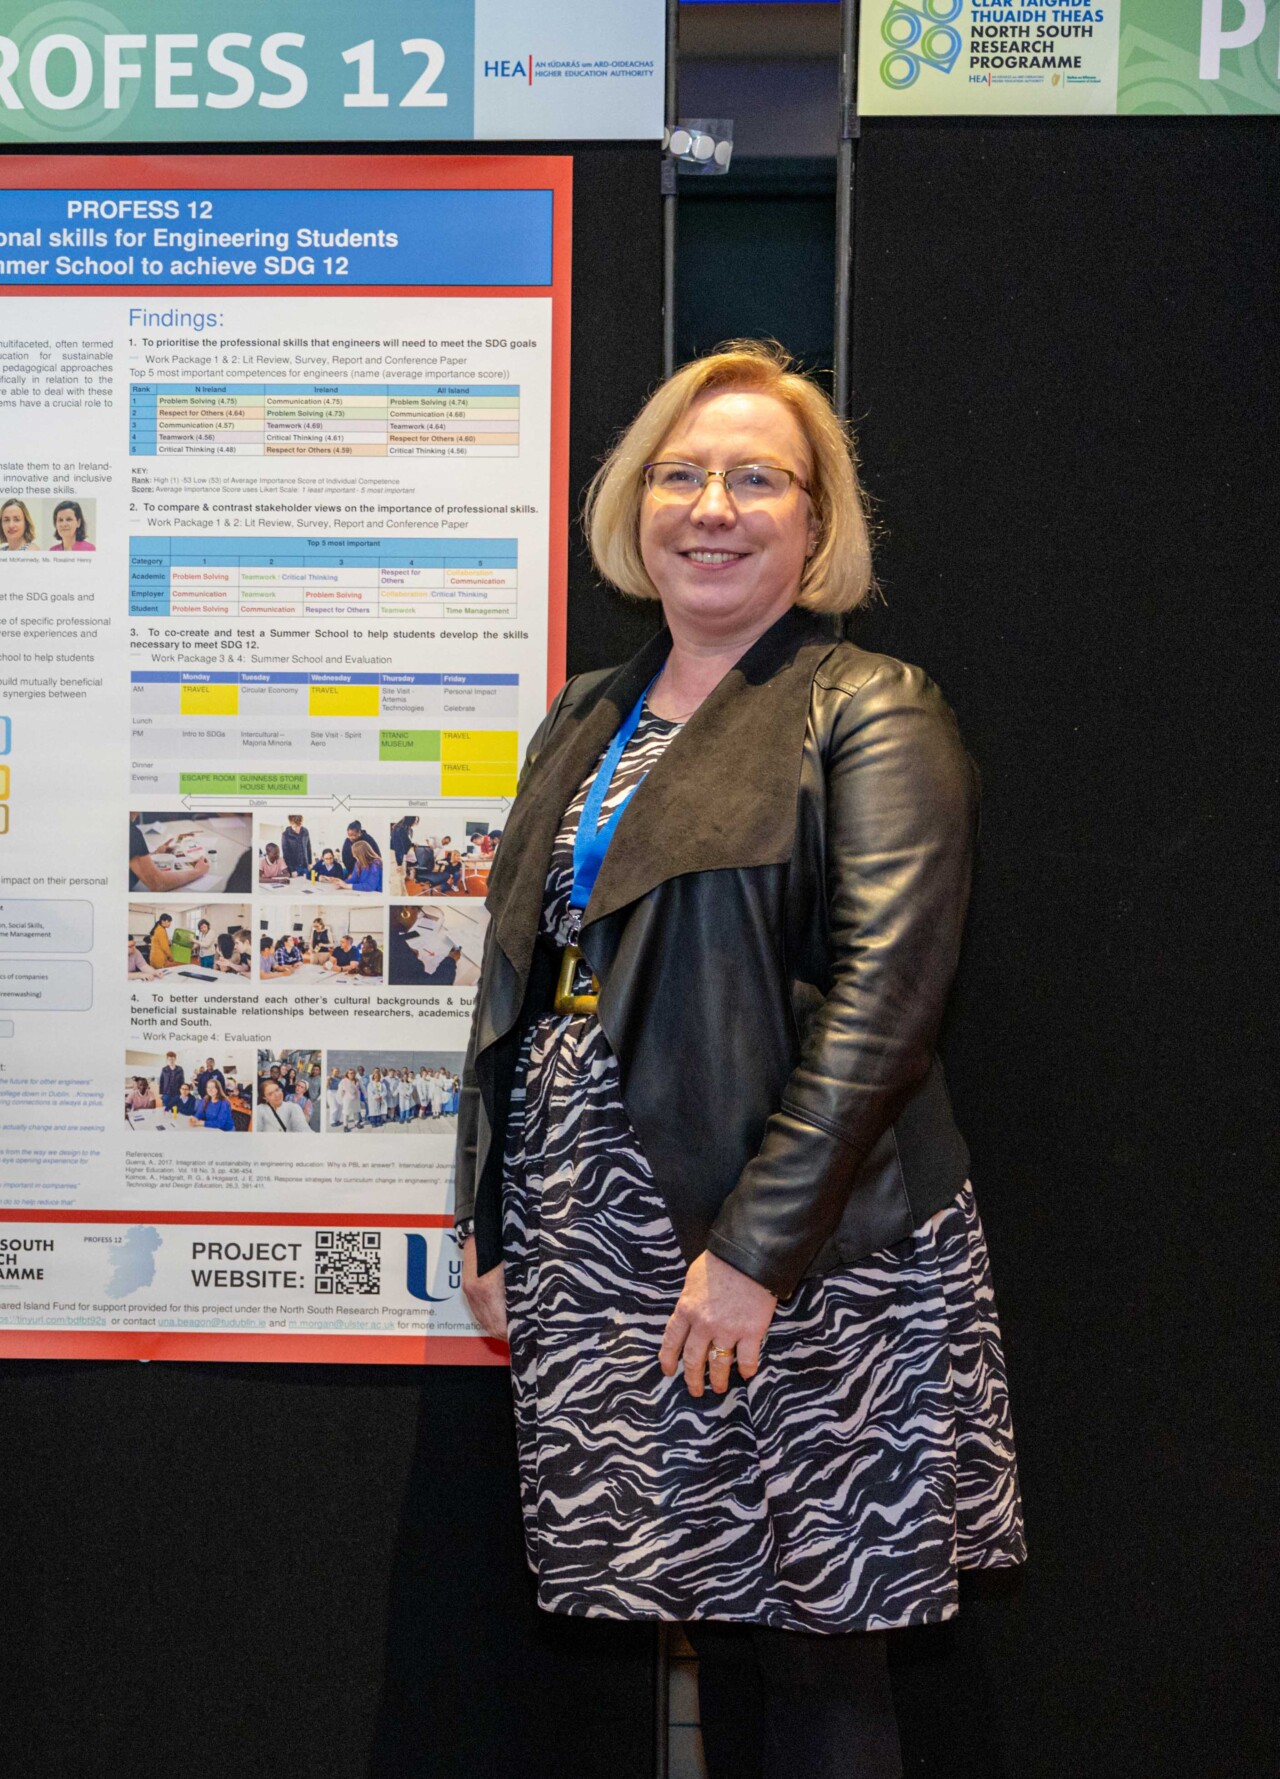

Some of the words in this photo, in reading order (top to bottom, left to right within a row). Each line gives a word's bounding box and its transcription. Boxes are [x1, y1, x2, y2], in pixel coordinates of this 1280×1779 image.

[971, 10, 1046, 22] THUAIDH
[1052, 10, 1103, 22] THEAS
[971, 26, 1029, 38] NORTH
[1037, 25, 1092, 37] SOUTH
[971, 41, 1054, 53] RESEARCH
[970, 56, 1081, 68] PROGRAMME
[342, 39, 447, 107] 12
[484, 60, 526, 77] HEA
[548, 60, 580, 68] tÚDARÁS
[969, 75, 988, 83] HEA
[68, 200, 179, 219] PROFESS
[188, 201, 212, 219] 12
[49, 228, 107, 247] skills
[115, 229, 146, 247] for
[154, 228, 288, 251] Engineering
[297, 228, 398, 247] Students
[56, 256, 133, 275] School
[141, 258, 163, 275] to
[170, 257, 256, 275] achieve
[264, 256, 314, 275] SDG
[323, 257, 348, 274] 12
[129, 308, 224, 331] Findings:
[56, 340, 78, 348] often
[142, 338, 153, 346] To
[157, 339, 199, 348] prioritise
[221, 339, 279, 348] professional
[334, 339, 379, 348] engineers
[383, 339, 399, 347] will
[403, 339, 425, 347] need
[486, 339, 507, 347] SDG
[510, 340, 536, 349] goals
[40, 352, 51, 360] for
[62, 352, 113, 360] sustainable
[79, 462, 111, 470] Ireland-
[130, 503, 137, 511] 2.
[144, 503, 155, 511] To
[158, 505, 199, 513] compare
[255, 504, 312, 512] stakeholder
[378, 505, 432, 514] importance
[435, 505, 444, 513] of
[447, 505, 507, 514] professional
[510, 505, 538, 513] skills.
[183, 672, 210, 682] Monday
[242, 673, 270, 683] Tuesday
[312, 673, 352, 682] Wednesday
[382, 674, 415, 684] Thursday
[444, 674, 466, 684] Friday
[382, 732, 409, 740] TITANIC
[382, 740, 414, 748] MUSEUM
[182, 774, 212, 782] ESCAPE
[214, 774, 236, 782] ROOM
[160, 1018, 178, 1026] and
[181, 1018, 211, 1026] South.
[142, 1032, 166, 1041] Work
[169, 1032, 209, 1043] Package
[211, 1032, 220, 1041] 4:
[225, 1033, 272, 1042] Evaluation
[0, 1239, 53, 1251] SOUTH
[193, 1243, 302, 1261] PROJECT
[191, 1270, 304, 1288] WEBSITE:
